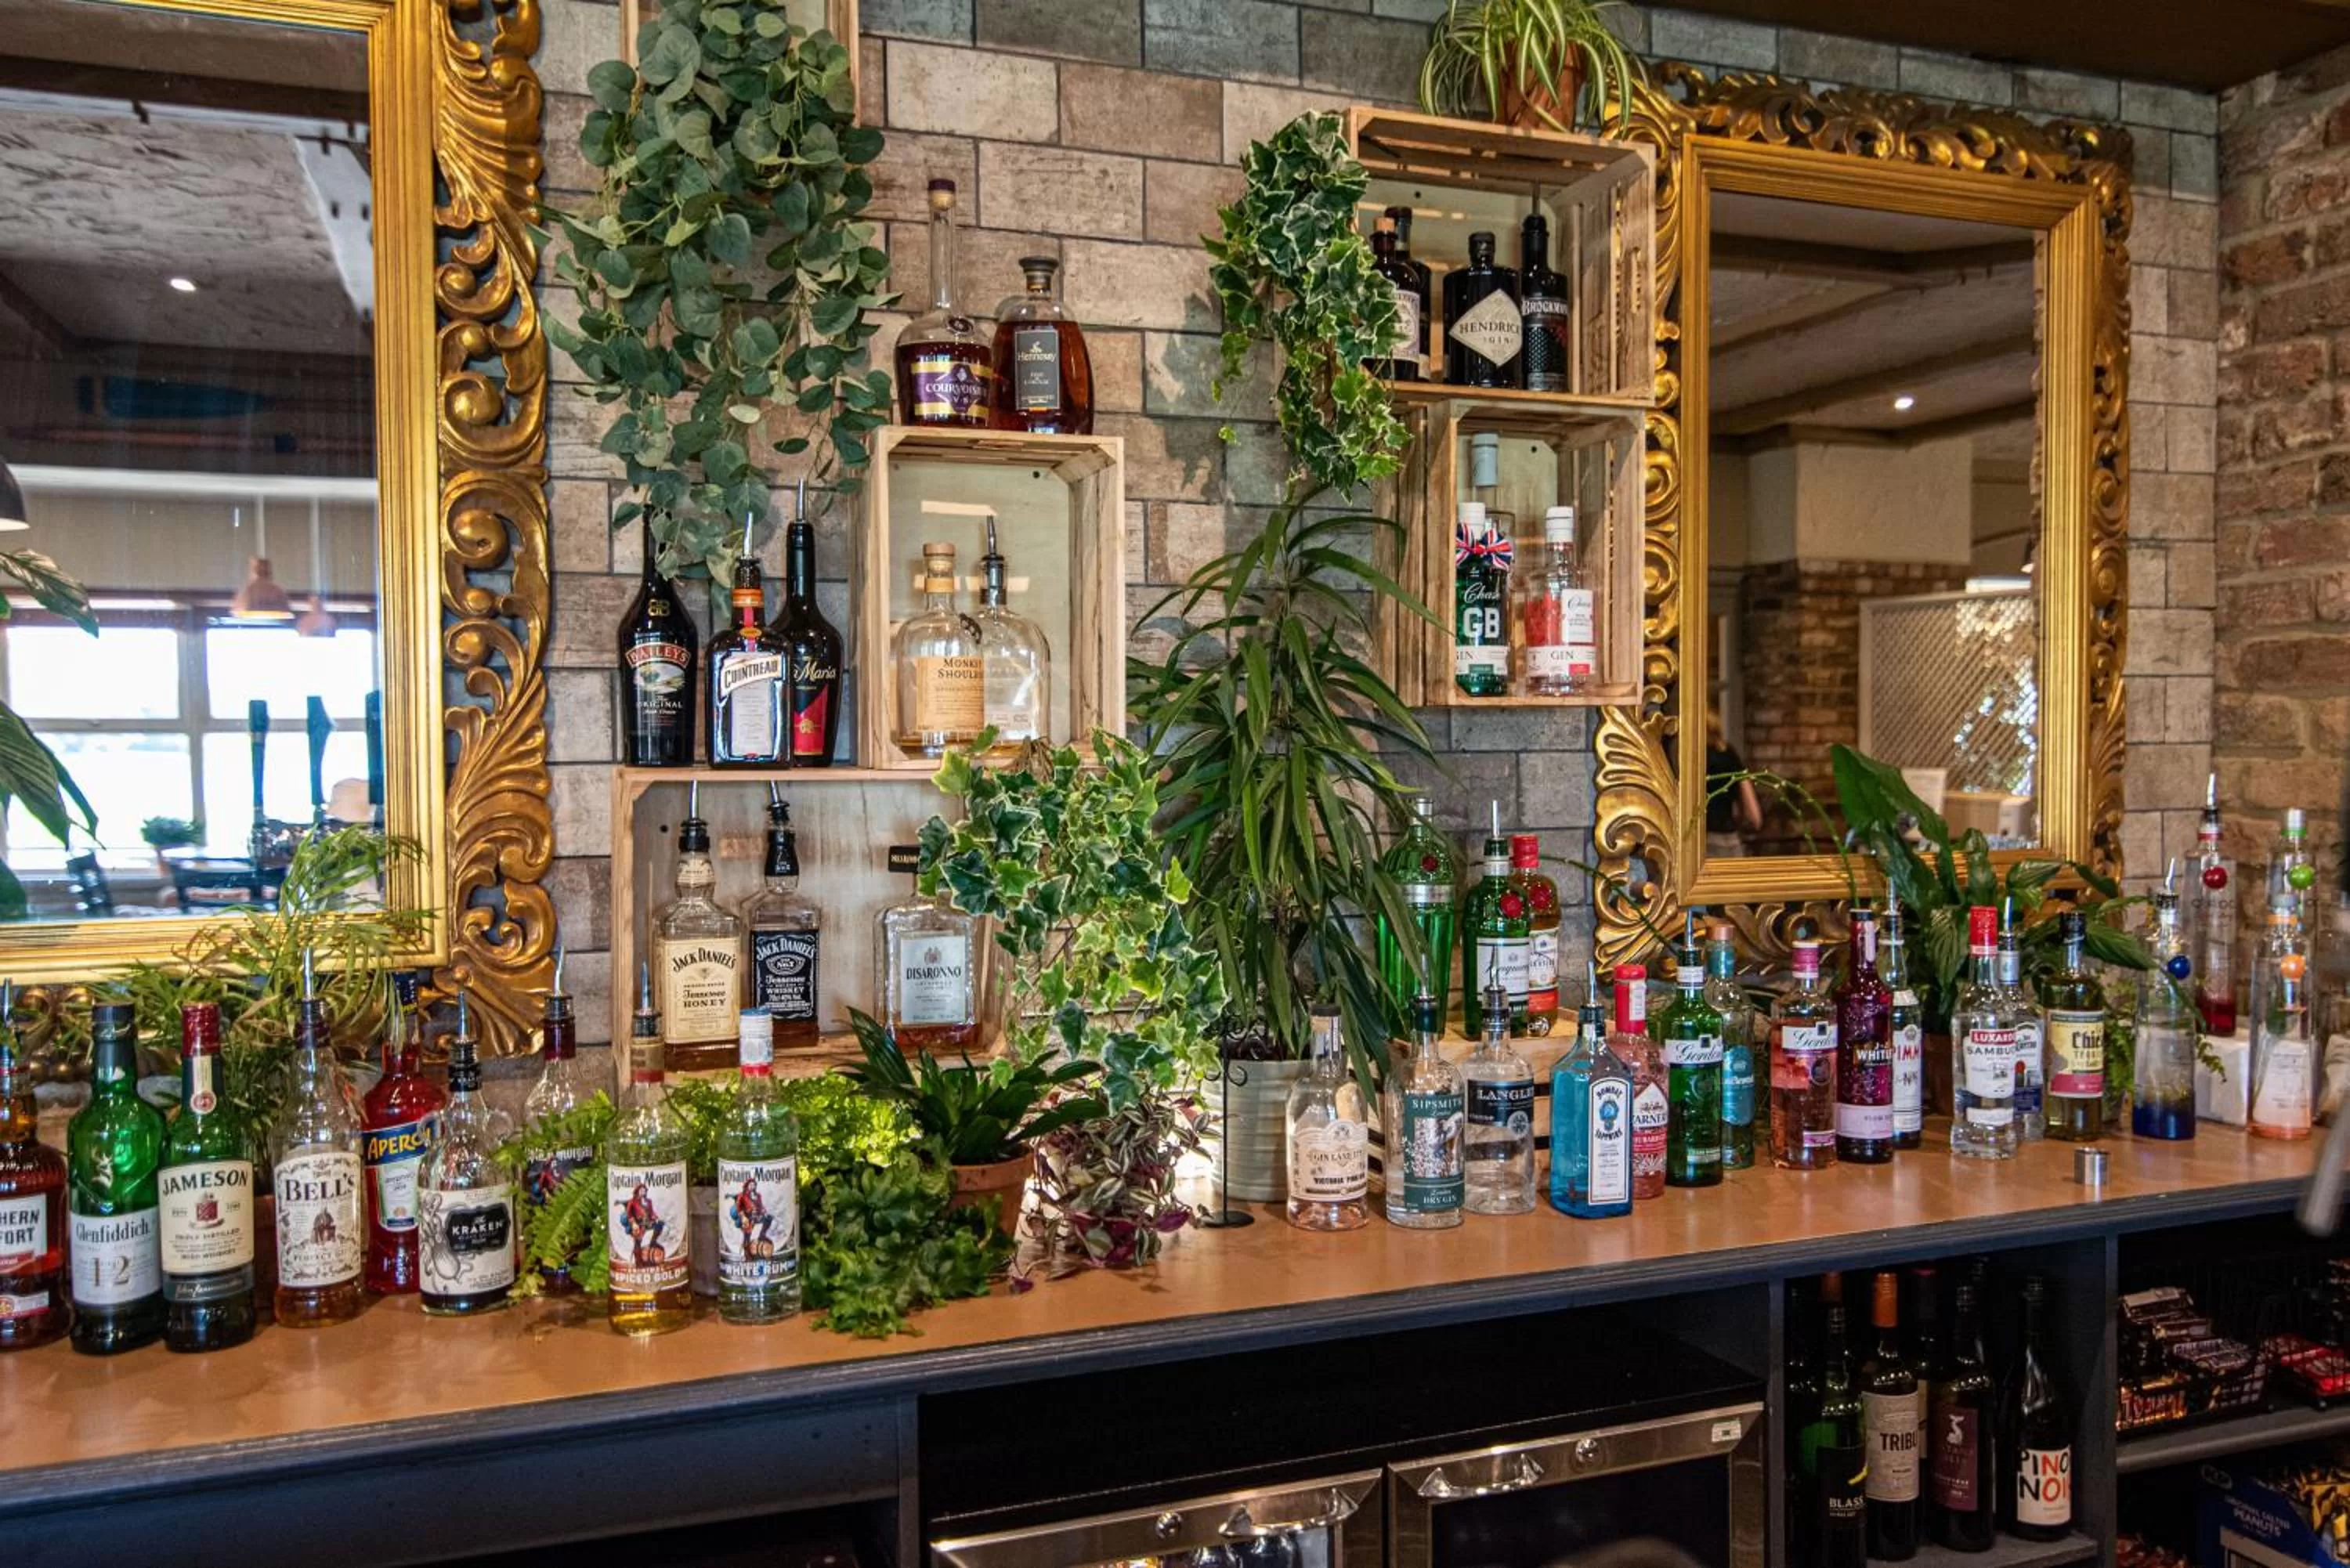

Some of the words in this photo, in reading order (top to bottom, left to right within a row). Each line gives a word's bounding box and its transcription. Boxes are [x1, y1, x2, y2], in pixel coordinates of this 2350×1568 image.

[1018, 352, 1057, 363] Hennessy
[1463, 607, 1500, 638] GB
[629, 646, 687, 663] BAILEYS
[1550, 651, 1574, 660] GIN
[724, 659, 779, 688] COINTREAU
[794, 658, 837, 682] Maria
[756, 941, 780, 961] JACK
[780, 938, 815, 959] DANIEL'S
[671, 952, 698, 973] JACK
[698, 947, 737, 970] DANIEL'S
[906, 966, 962, 980] DISARONNO
[682, 989, 726, 999] Tennessee
[683, 999, 726, 1008] HONEY
[1596, 1086, 1623, 1100] BOMBAY
[1595, 1128, 1623, 1141] SAPPHIRE
[162, 1169, 248, 1196] JAMESON
[645, 1170, 682, 1188] Morgan
[721, 1165, 751, 1183] Captain
[754, 1165, 791, 1184] Morgan
[285, 1172, 355, 1201] BELL'S
[76, 1217, 150, 1244] Glenfiddich
[452, 1221, 503, 1235] KRAKEN
[92, 1255, 131, 1287] 12
[2019, 1476, 2070, 1503] NOI
